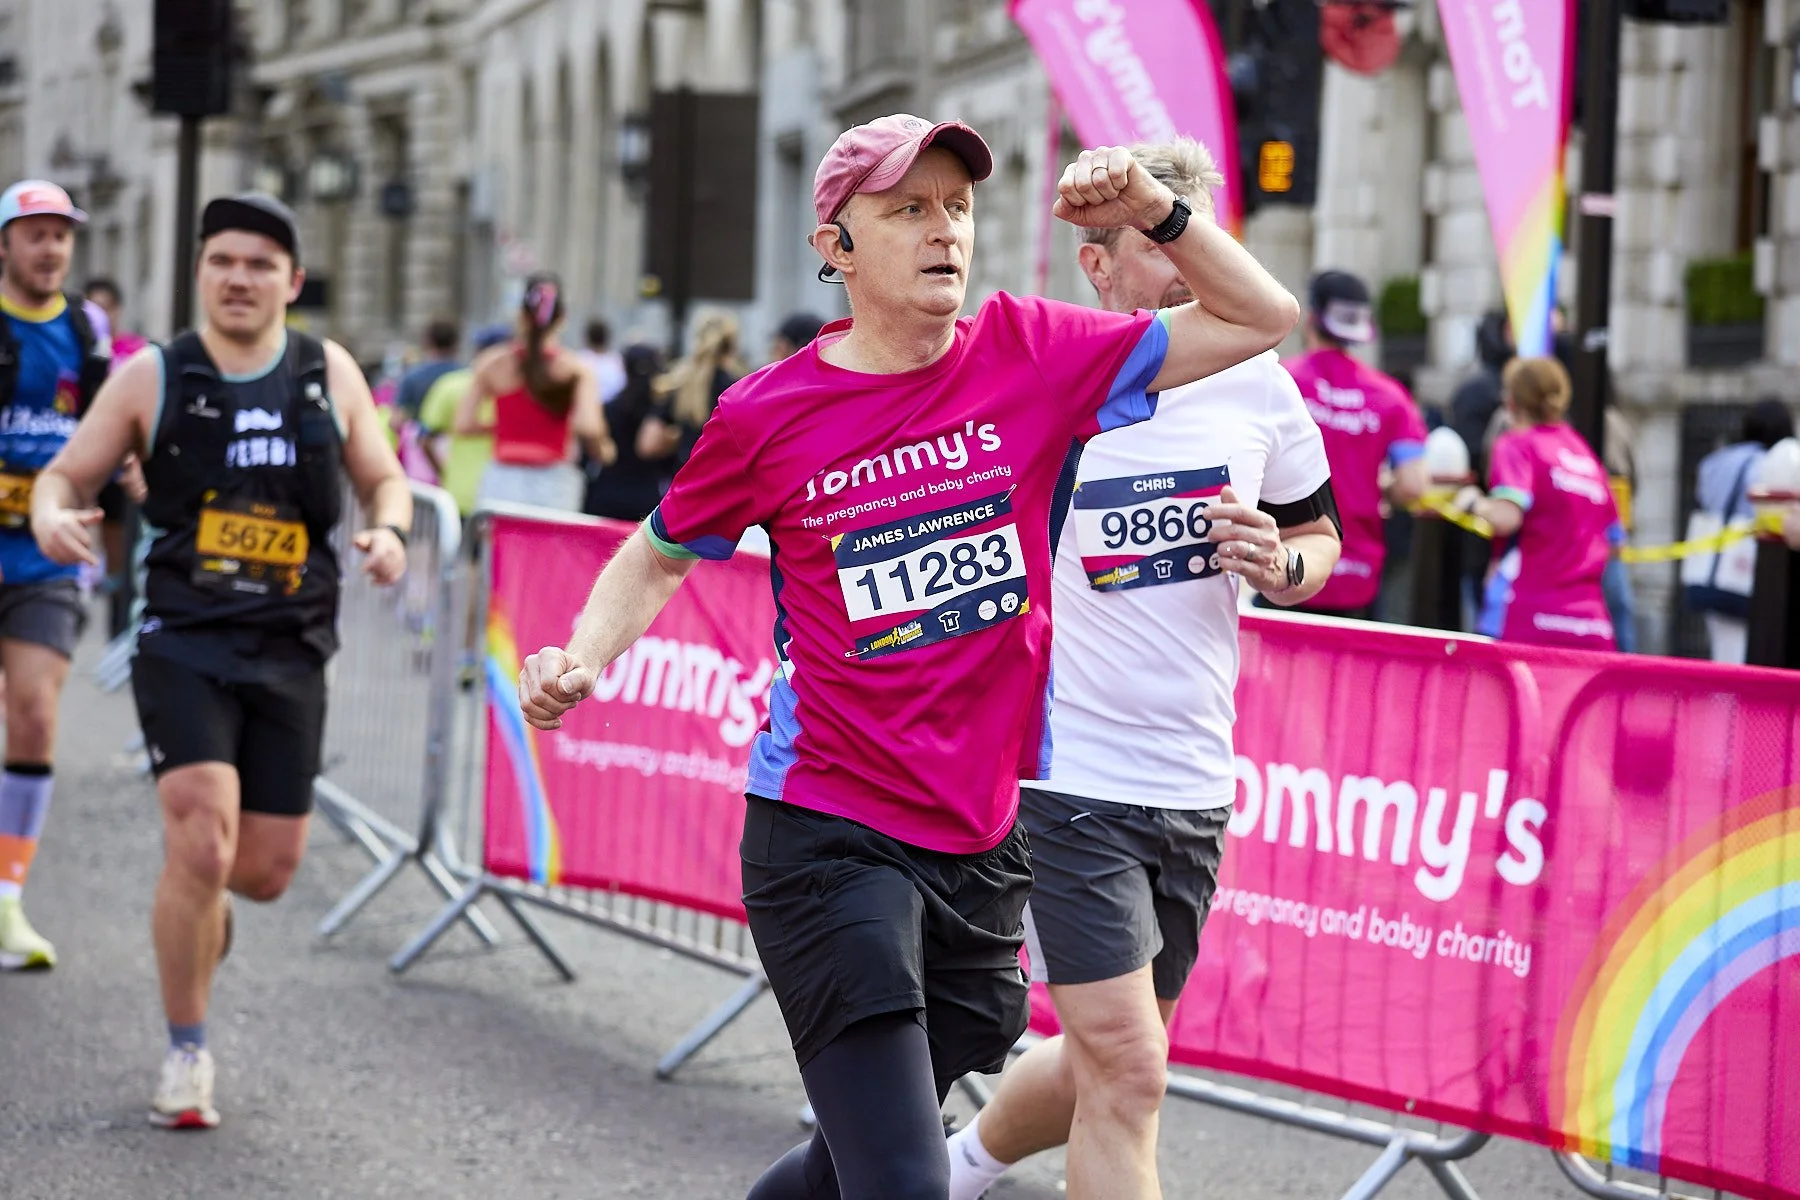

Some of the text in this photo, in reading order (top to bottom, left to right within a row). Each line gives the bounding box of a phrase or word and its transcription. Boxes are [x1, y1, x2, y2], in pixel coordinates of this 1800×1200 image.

[804, 420, 1002, 502] Tommy's
[1133, 477, 1176, 492] CHRIS
[802, 464, 1012, 529] The pregnancy and baby charity
[853, 503, 995, 552] JAMES LAWRENCE
[1101, 502, 1213, 549] 9866
[219, 520, 298, 554] 5674
[856, 534, 1012, 611] 11283
[574, 614, 771, 747] ommy'
[1226, 755, 1548, 902] ommy's
[1320, 905, 1366, 940] and
[1367, 906, 1432, 959] baby
[1436, 921, 1532, 977] charity
